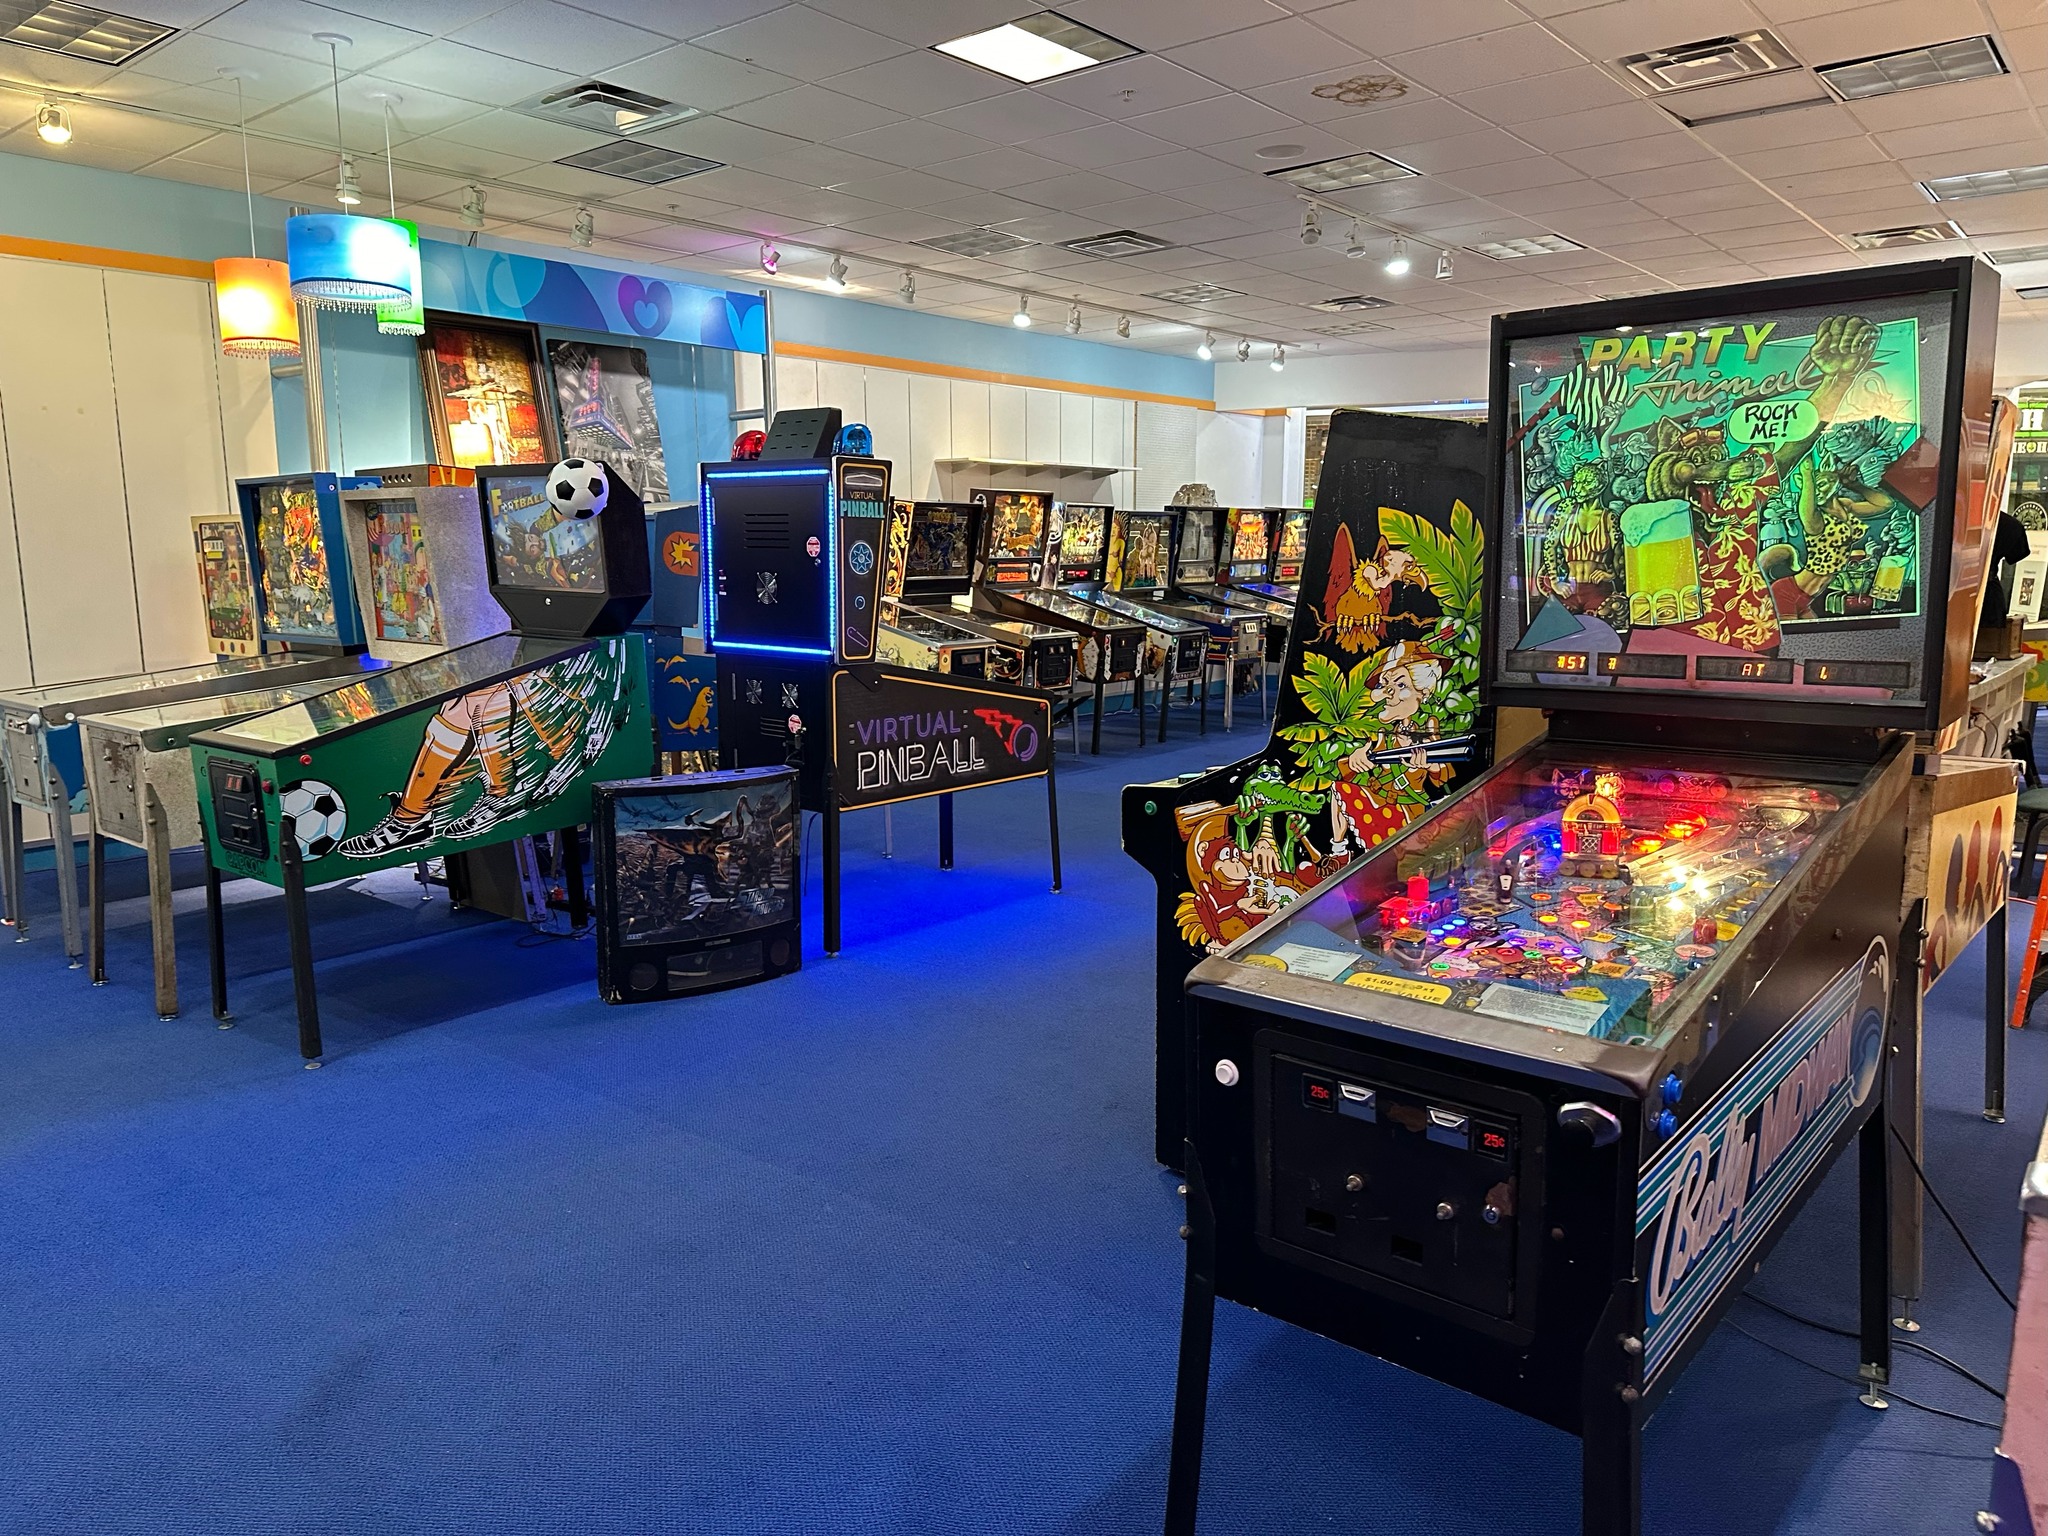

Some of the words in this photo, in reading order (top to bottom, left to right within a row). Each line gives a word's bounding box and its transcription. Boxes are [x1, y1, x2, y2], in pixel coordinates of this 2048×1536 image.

[1588, 322, 1778, 372] PARTY
[1626, 354, 1826, 408] Animal
[1744, 402, 1800, 423] ROCK
[1750, 420, 1789, 440] ME!
[840, 500, 886, 518] PINBALL
[849, 491, 876, 500] VIRTUAL
[856, 709, 961, 745] VIRTUAL
[856, 736, 986, 790] PINBALL
[1650, 1101, 1757, 1315] Bally
[1755, 1001, 1857, 1185] MIDWAY
